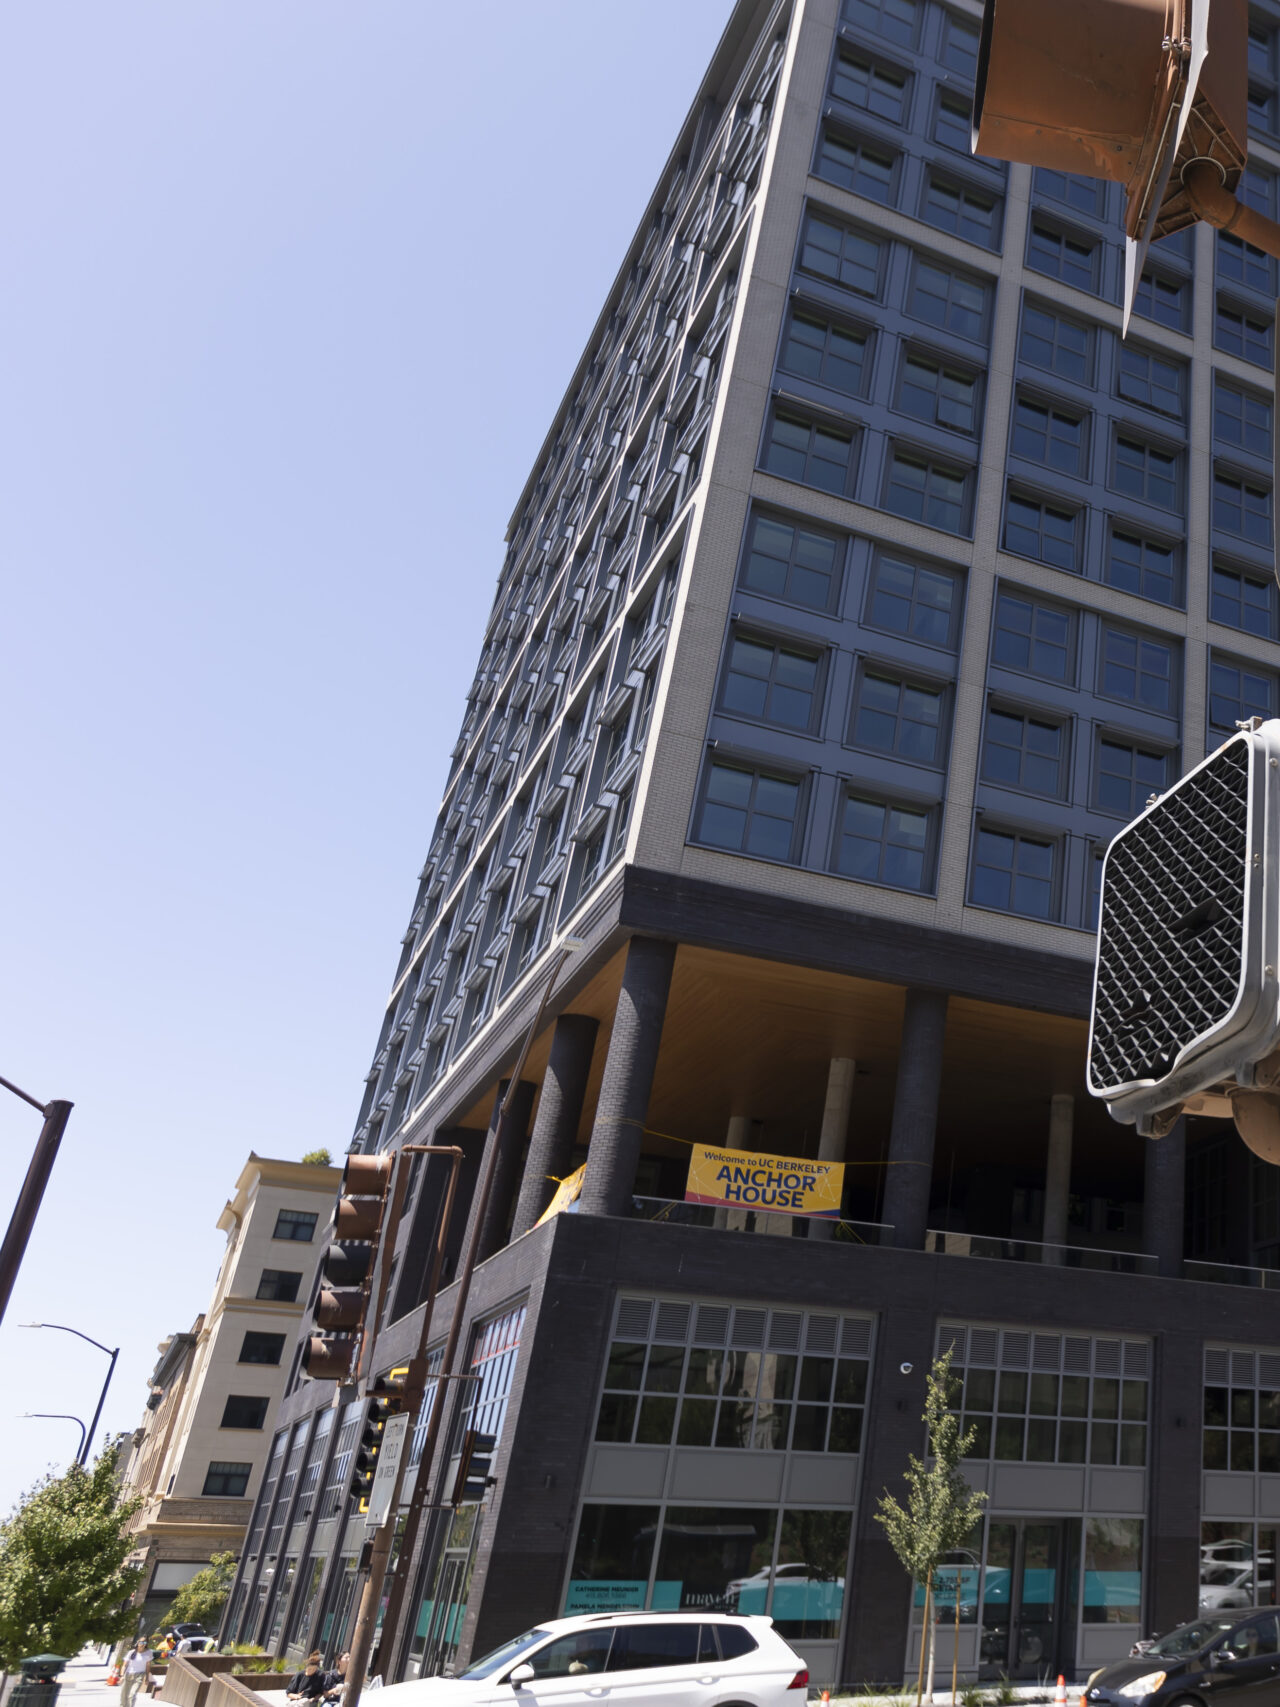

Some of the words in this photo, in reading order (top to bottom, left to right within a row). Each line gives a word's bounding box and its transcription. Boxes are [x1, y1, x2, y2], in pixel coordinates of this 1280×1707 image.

[704, 1152, 745, 1165] Welcome
[747, 1158, 757, 1166] to
[758, 1159, 774, 1168] UC
[776, 1161, 831, 1174] BERKELEY
[716, 1166, 816, 1192] ANCHOR
[725, 1184, 805, 1208] HOUSE
